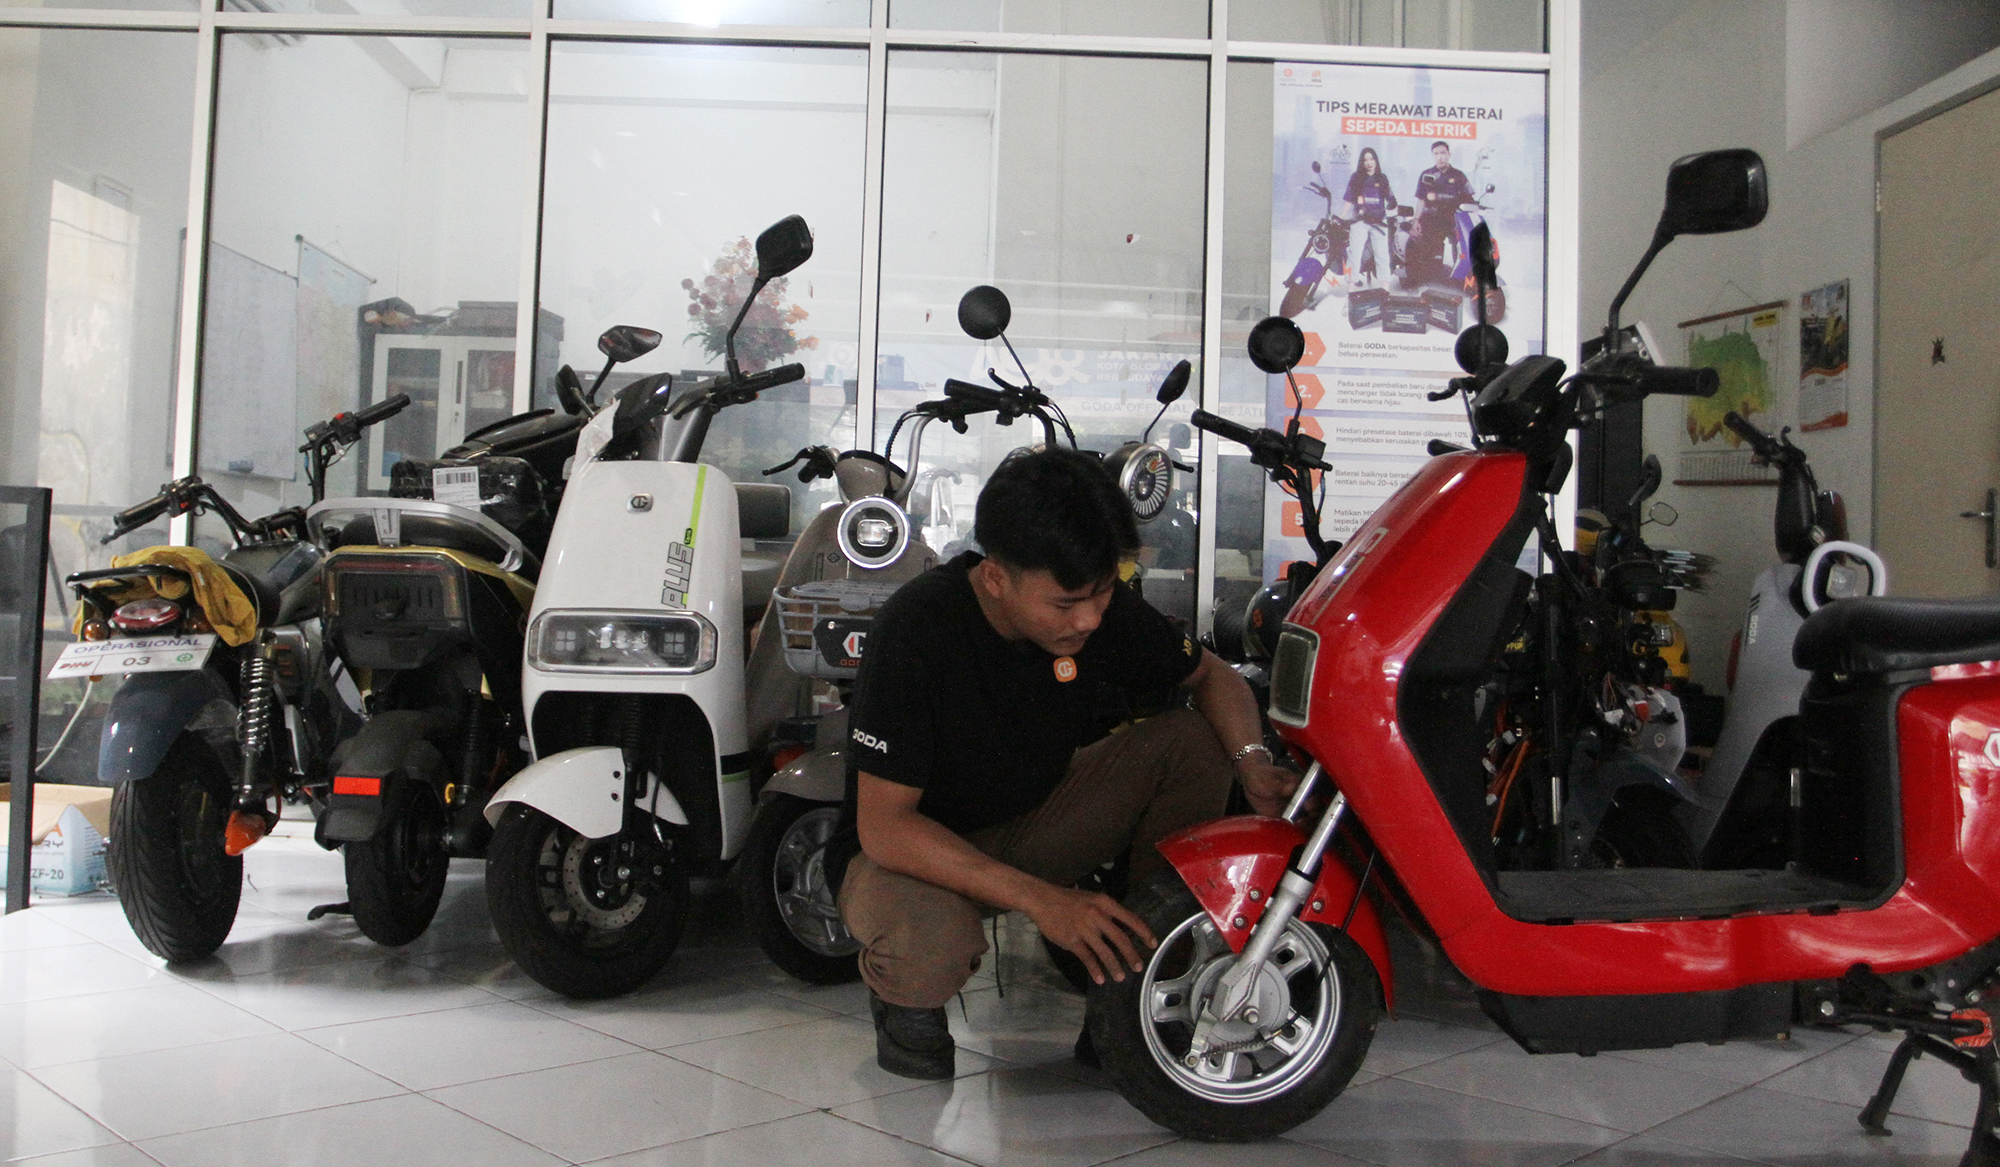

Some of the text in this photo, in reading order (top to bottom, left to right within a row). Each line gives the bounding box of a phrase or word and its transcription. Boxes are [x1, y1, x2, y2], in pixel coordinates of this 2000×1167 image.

[1316, 101, 1503, 120] TIPS MERAWAT BATERAI
[1346, 119, 1471, 137] SEPEDA LISTRIK
[1388, 344, 1431, 352] berkapasitas
[1096, 373, 1164, 382] BERUDAYA
[1372, 382, 1407, 390] pembelian
[1361, 470, 1388, 478] baiknya
[661, 541, 694, 609] PLUS
[74, 638, 202, 654] OPERASIONAL
[123, 656, 151, 666] 03
